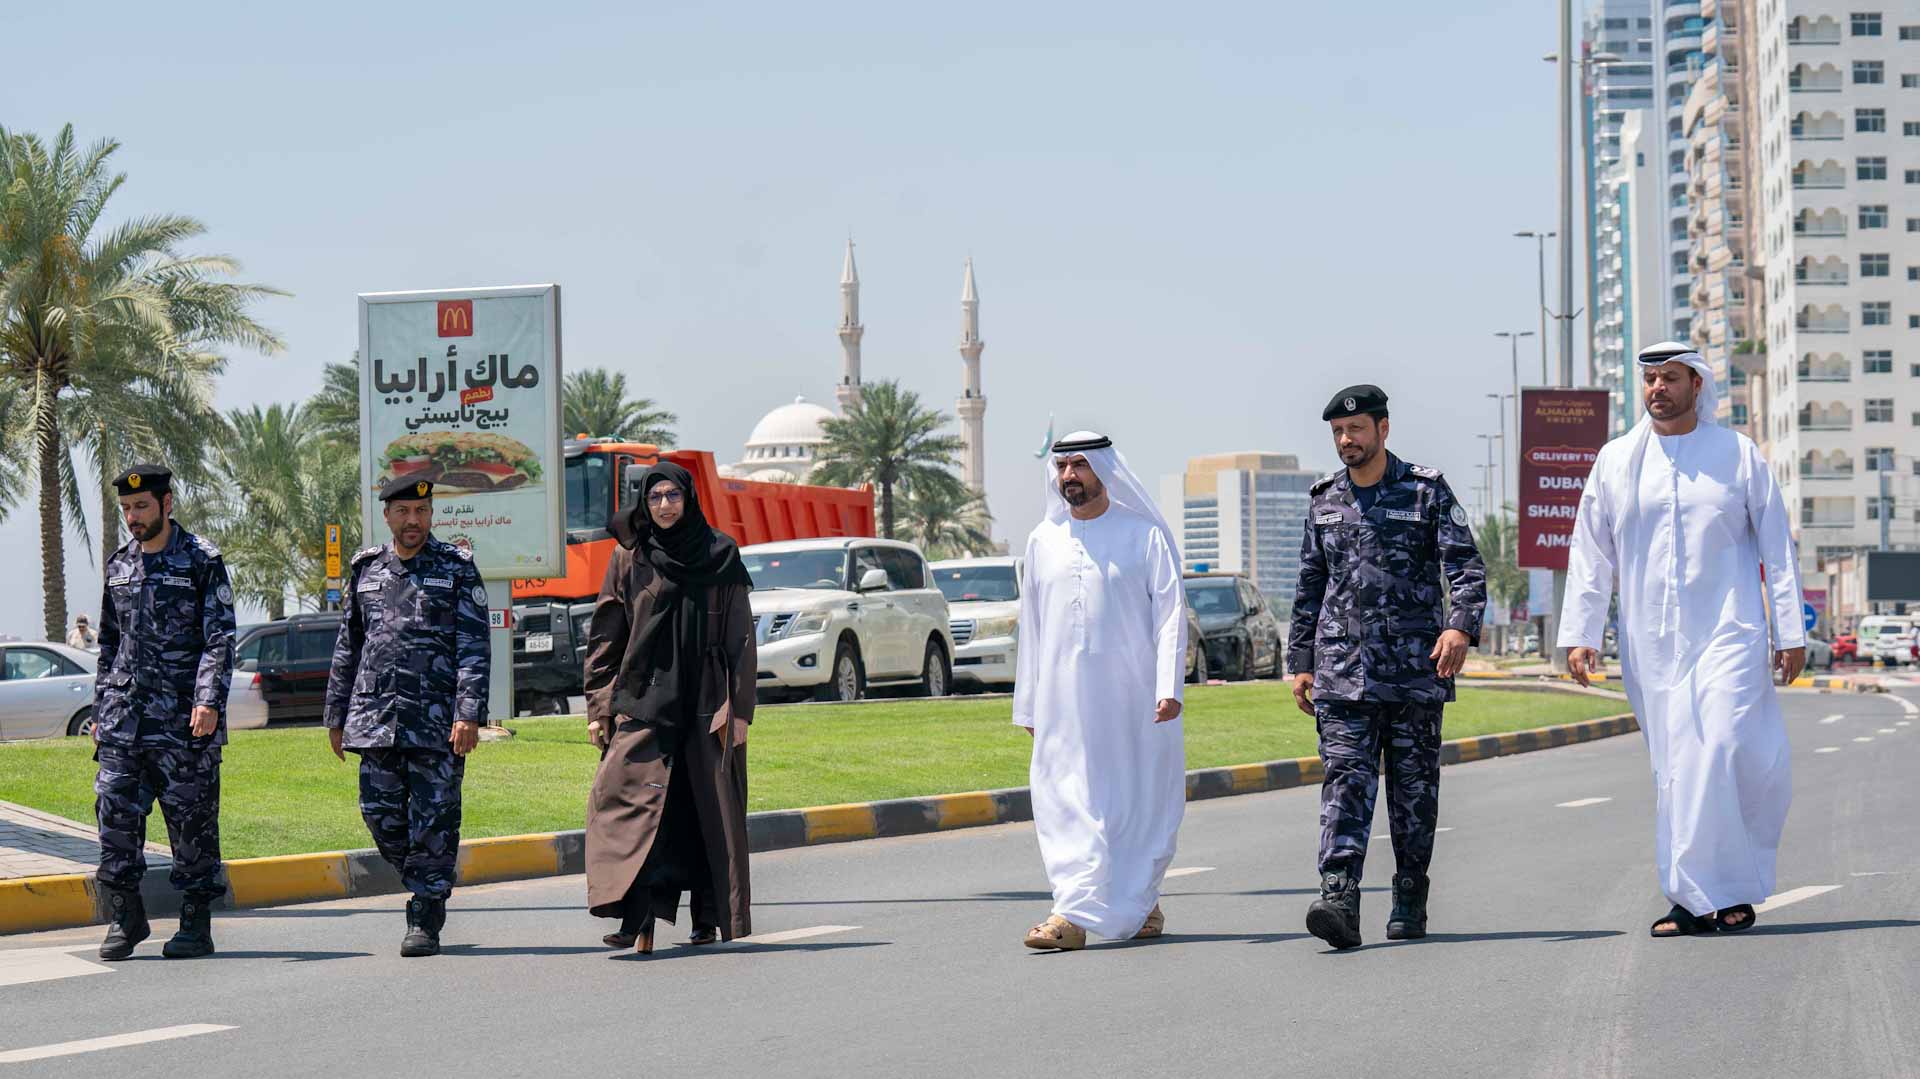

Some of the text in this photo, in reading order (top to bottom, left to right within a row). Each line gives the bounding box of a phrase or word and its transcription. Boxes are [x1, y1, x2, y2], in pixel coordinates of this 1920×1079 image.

[374, 344, 539, 404] ماك أرابيا
[464, 387, 491, 404] بطعم
[405, 403, 509, 435] بيج تايستي
[1532, 452, 1597, 462] DELIVERY TO
[442, 505, 454, 514] لك
[1527, 504, 1576, 519] SHARJ
[1536, 532, 1574, 548] AJM
[491, 613, 501, 625] 98
